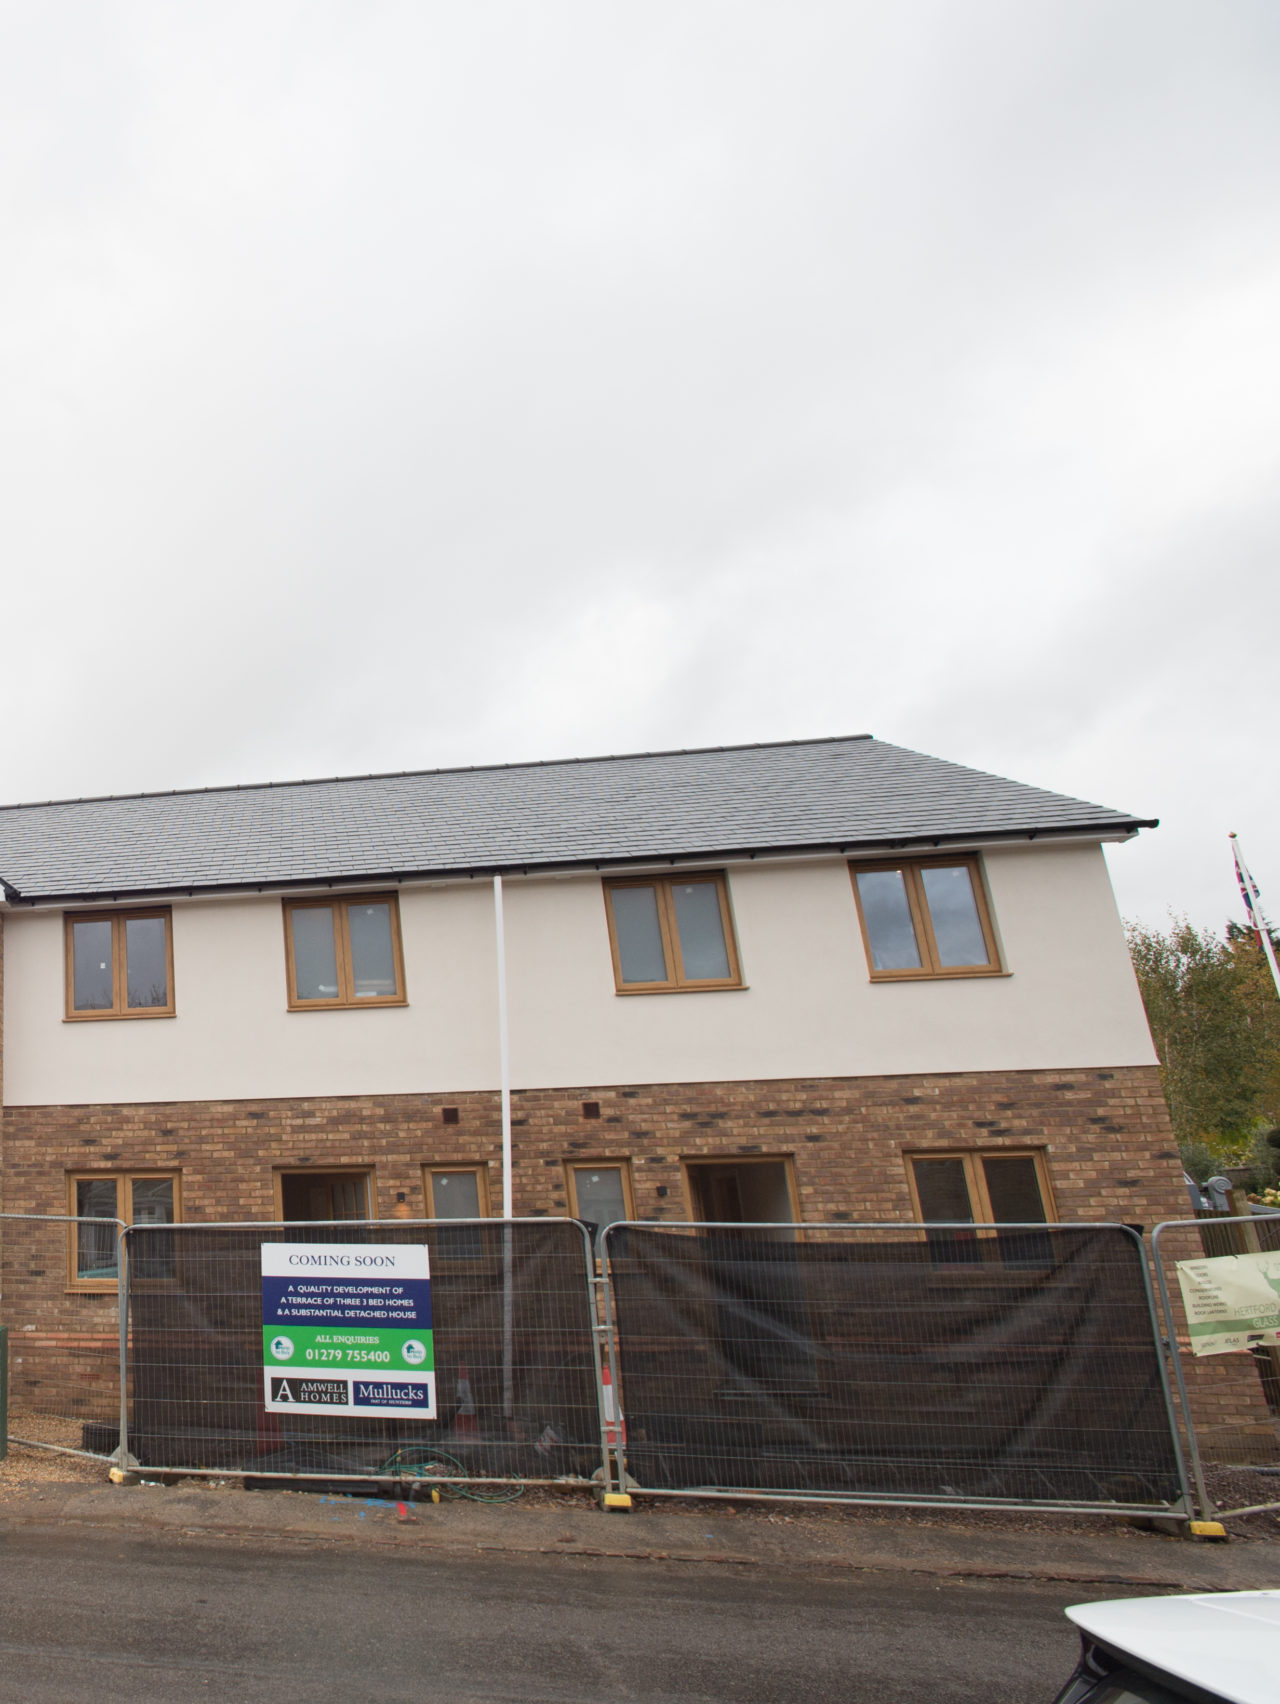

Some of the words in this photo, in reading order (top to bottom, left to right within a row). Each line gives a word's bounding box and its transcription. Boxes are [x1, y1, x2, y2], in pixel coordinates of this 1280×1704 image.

[289, 1254, 351, 1266] COMING
[354, 1255, 396, 1267] SOON
[297, 1285, 332, 1294] QUALITY
[333, 1286, 391, 1294] DEVELOPMENT
[280, 1296, 287, 1304] A
[287, 1296, 323, 1305] TERRACE
[323, 1297, 335, 1305] OF
[336, 1297, 361, 1306] THREE
[362, 1298, 367, 1306] 3
[368, 1298, 384, 1306] BED
[385, 1299, 414, 1307] HOMES
[291, 1308, 344, 1317] SUBSTANTIAL
[344, 1310, 388, 1318] DETACHED
[389, 1310, 417, 1319] HOUSE
[1234, 1302, 1277, 1317] HERTFORD
[1253, 1315, 1279, 1328] GLASS
[315, 1335, 332, 1343] ALL
[333, 1335, 380, 1345] ENQUIRIES
[306, 1348, 342, 1360] 01279
[346, 1350, 391, 1362] 755400
[274, 1379, 296, 1402] A
[300, 1382, 347, 1393] AMWELL
[359, 1384, 424, 1400] Mullucks
[300, 1392, 348, 1403] HOMES
